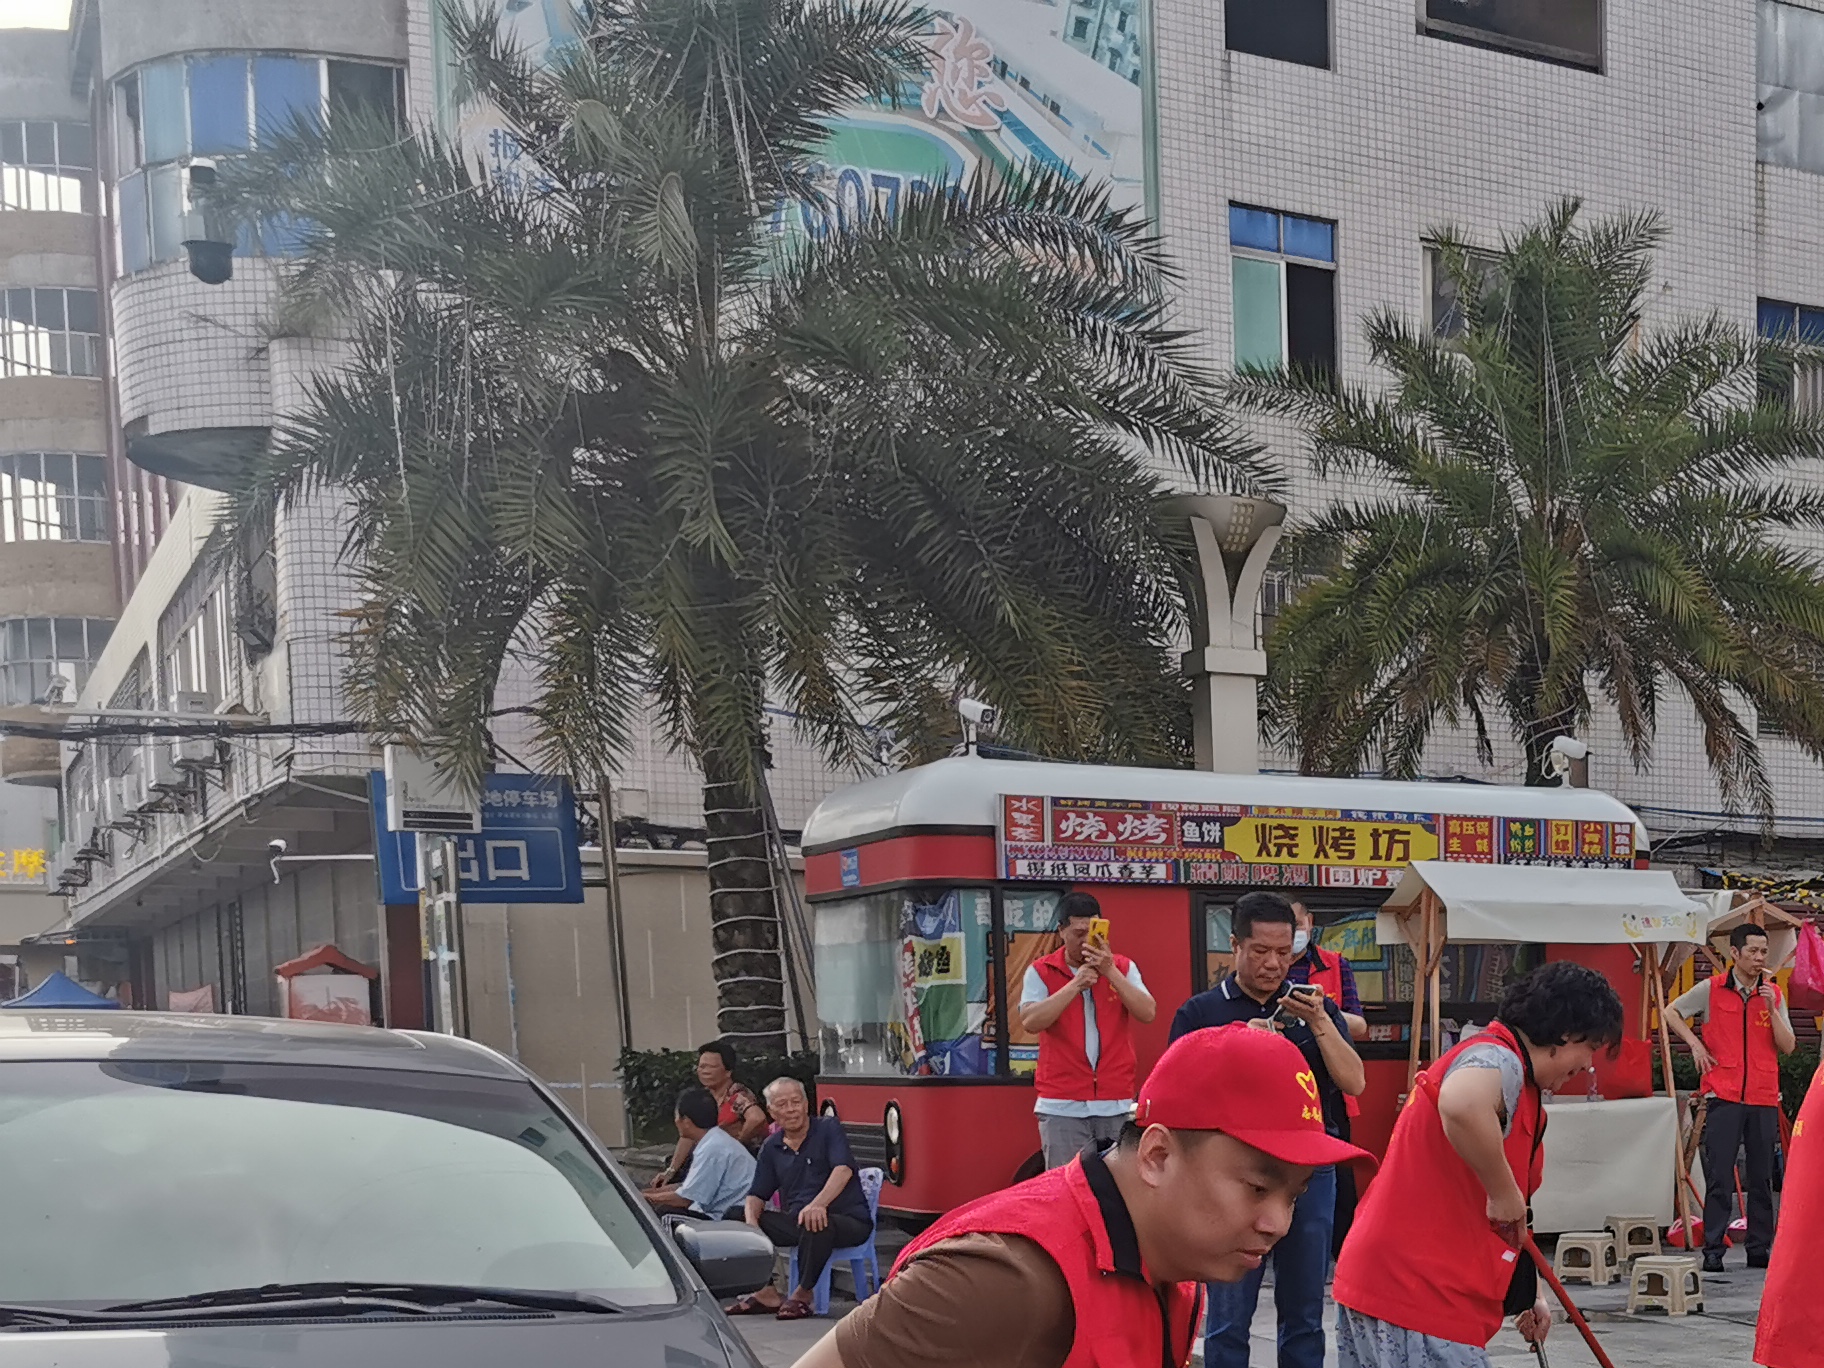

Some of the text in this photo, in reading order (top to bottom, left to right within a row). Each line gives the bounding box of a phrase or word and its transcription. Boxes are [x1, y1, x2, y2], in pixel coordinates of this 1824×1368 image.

[920, 15, 1008, 131] 您
[1059, 811, 1171, 845] 烧烤
[1182, 819, 1222, 844] 鱼饼
[1255, 823, 1411, 861] 烧烤坊
